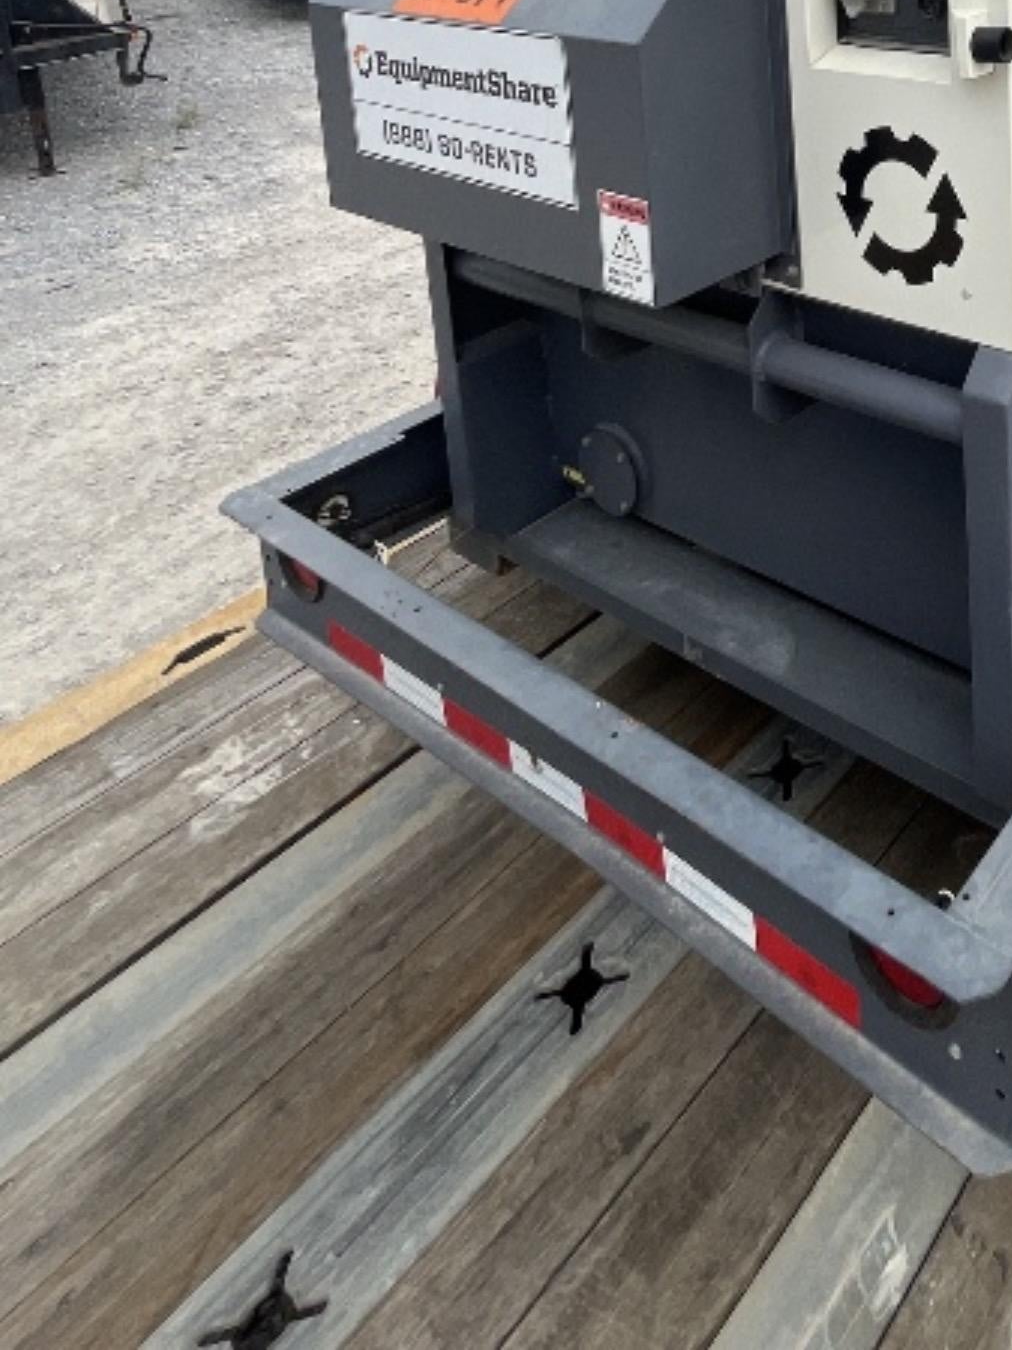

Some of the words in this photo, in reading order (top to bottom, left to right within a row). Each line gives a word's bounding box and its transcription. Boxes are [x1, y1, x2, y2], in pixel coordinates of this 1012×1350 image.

[374, 50, 558, 108] EquipmentShare
[382, 118, 433, 154] (888)
[437, 134, 538, 178] 80-RENTS
